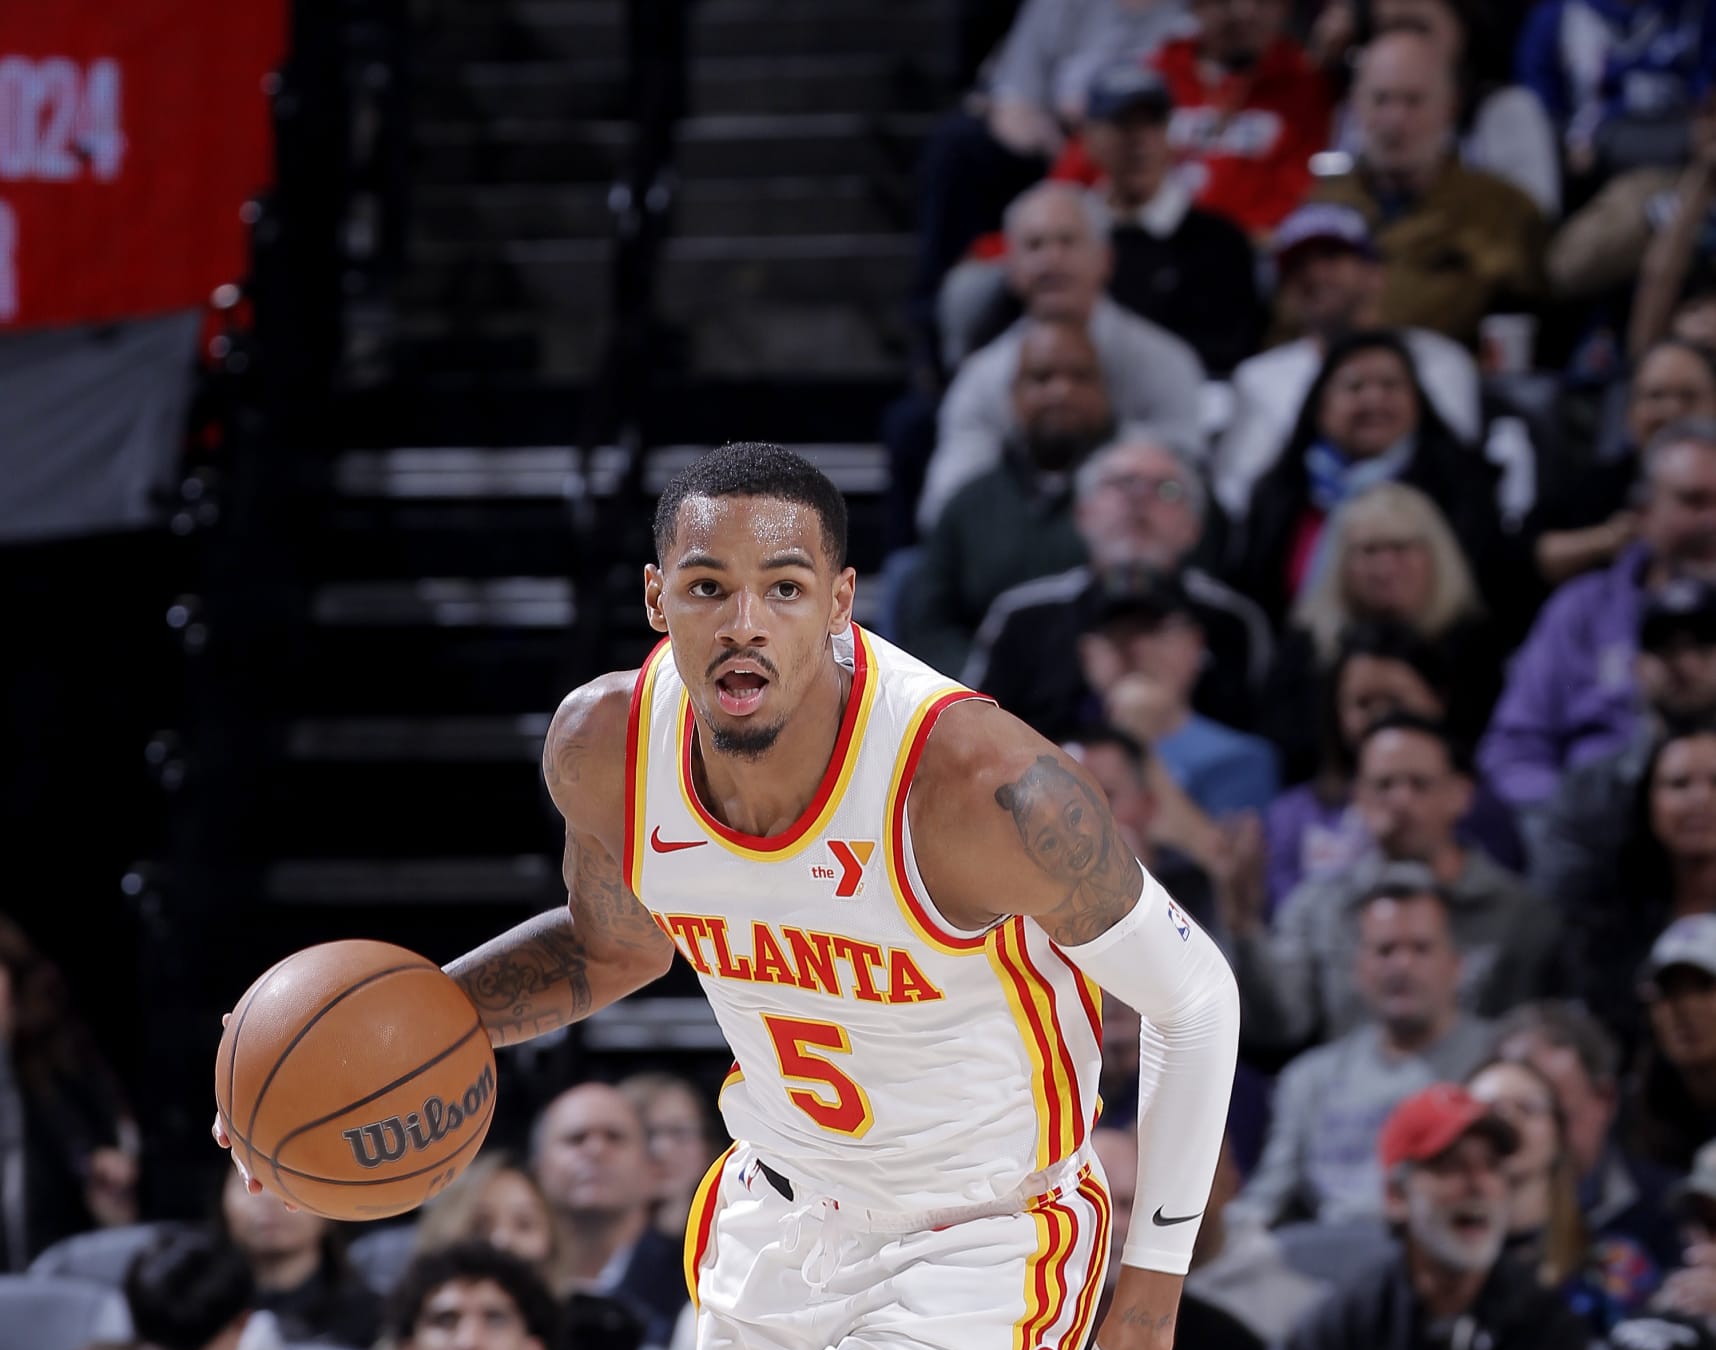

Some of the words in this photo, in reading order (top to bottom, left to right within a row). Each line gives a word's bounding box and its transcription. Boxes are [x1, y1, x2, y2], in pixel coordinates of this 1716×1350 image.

[811, 865, 835, 879] the
[342, 1063, 495, 1169] Wilson
[759, 1012, 875, 1139] 5
